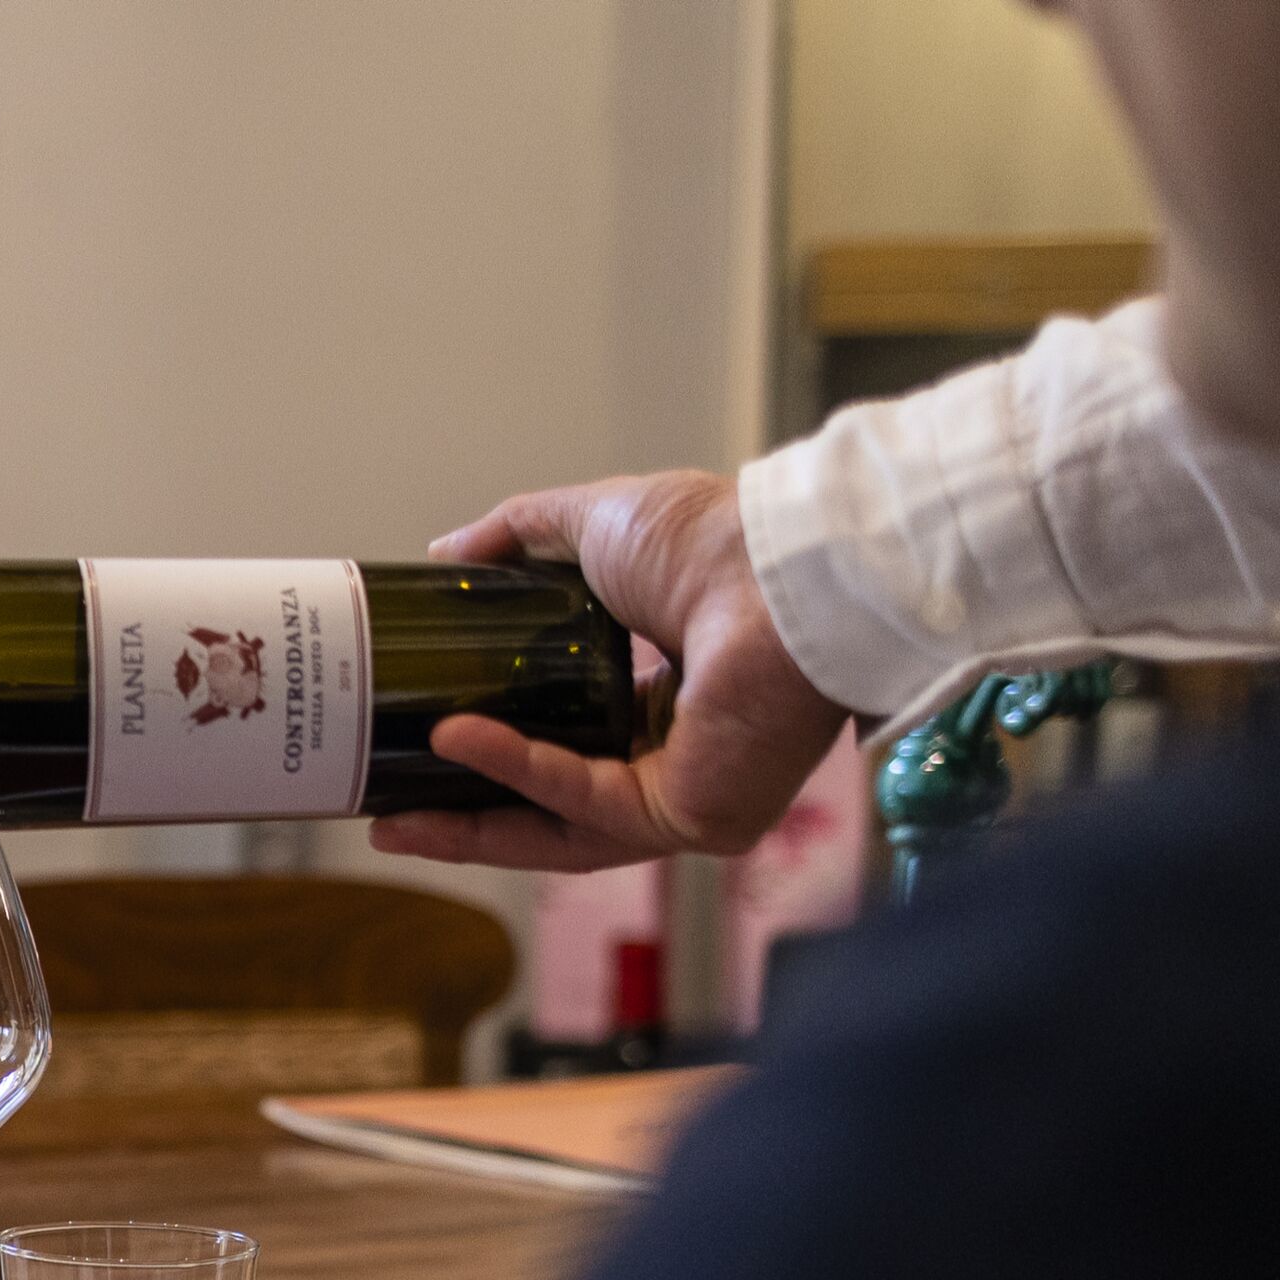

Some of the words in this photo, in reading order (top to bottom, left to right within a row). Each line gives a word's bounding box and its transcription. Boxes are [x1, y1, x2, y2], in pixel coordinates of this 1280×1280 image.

[308, 606, 320, 636] DOC
[121, 622, 144, 736] PLANETA
[281, 587, 305, 774] CONTRODANZA
[310, 641, 323, 686] NOTO
[309, 691, 324, 750] SICILIA
